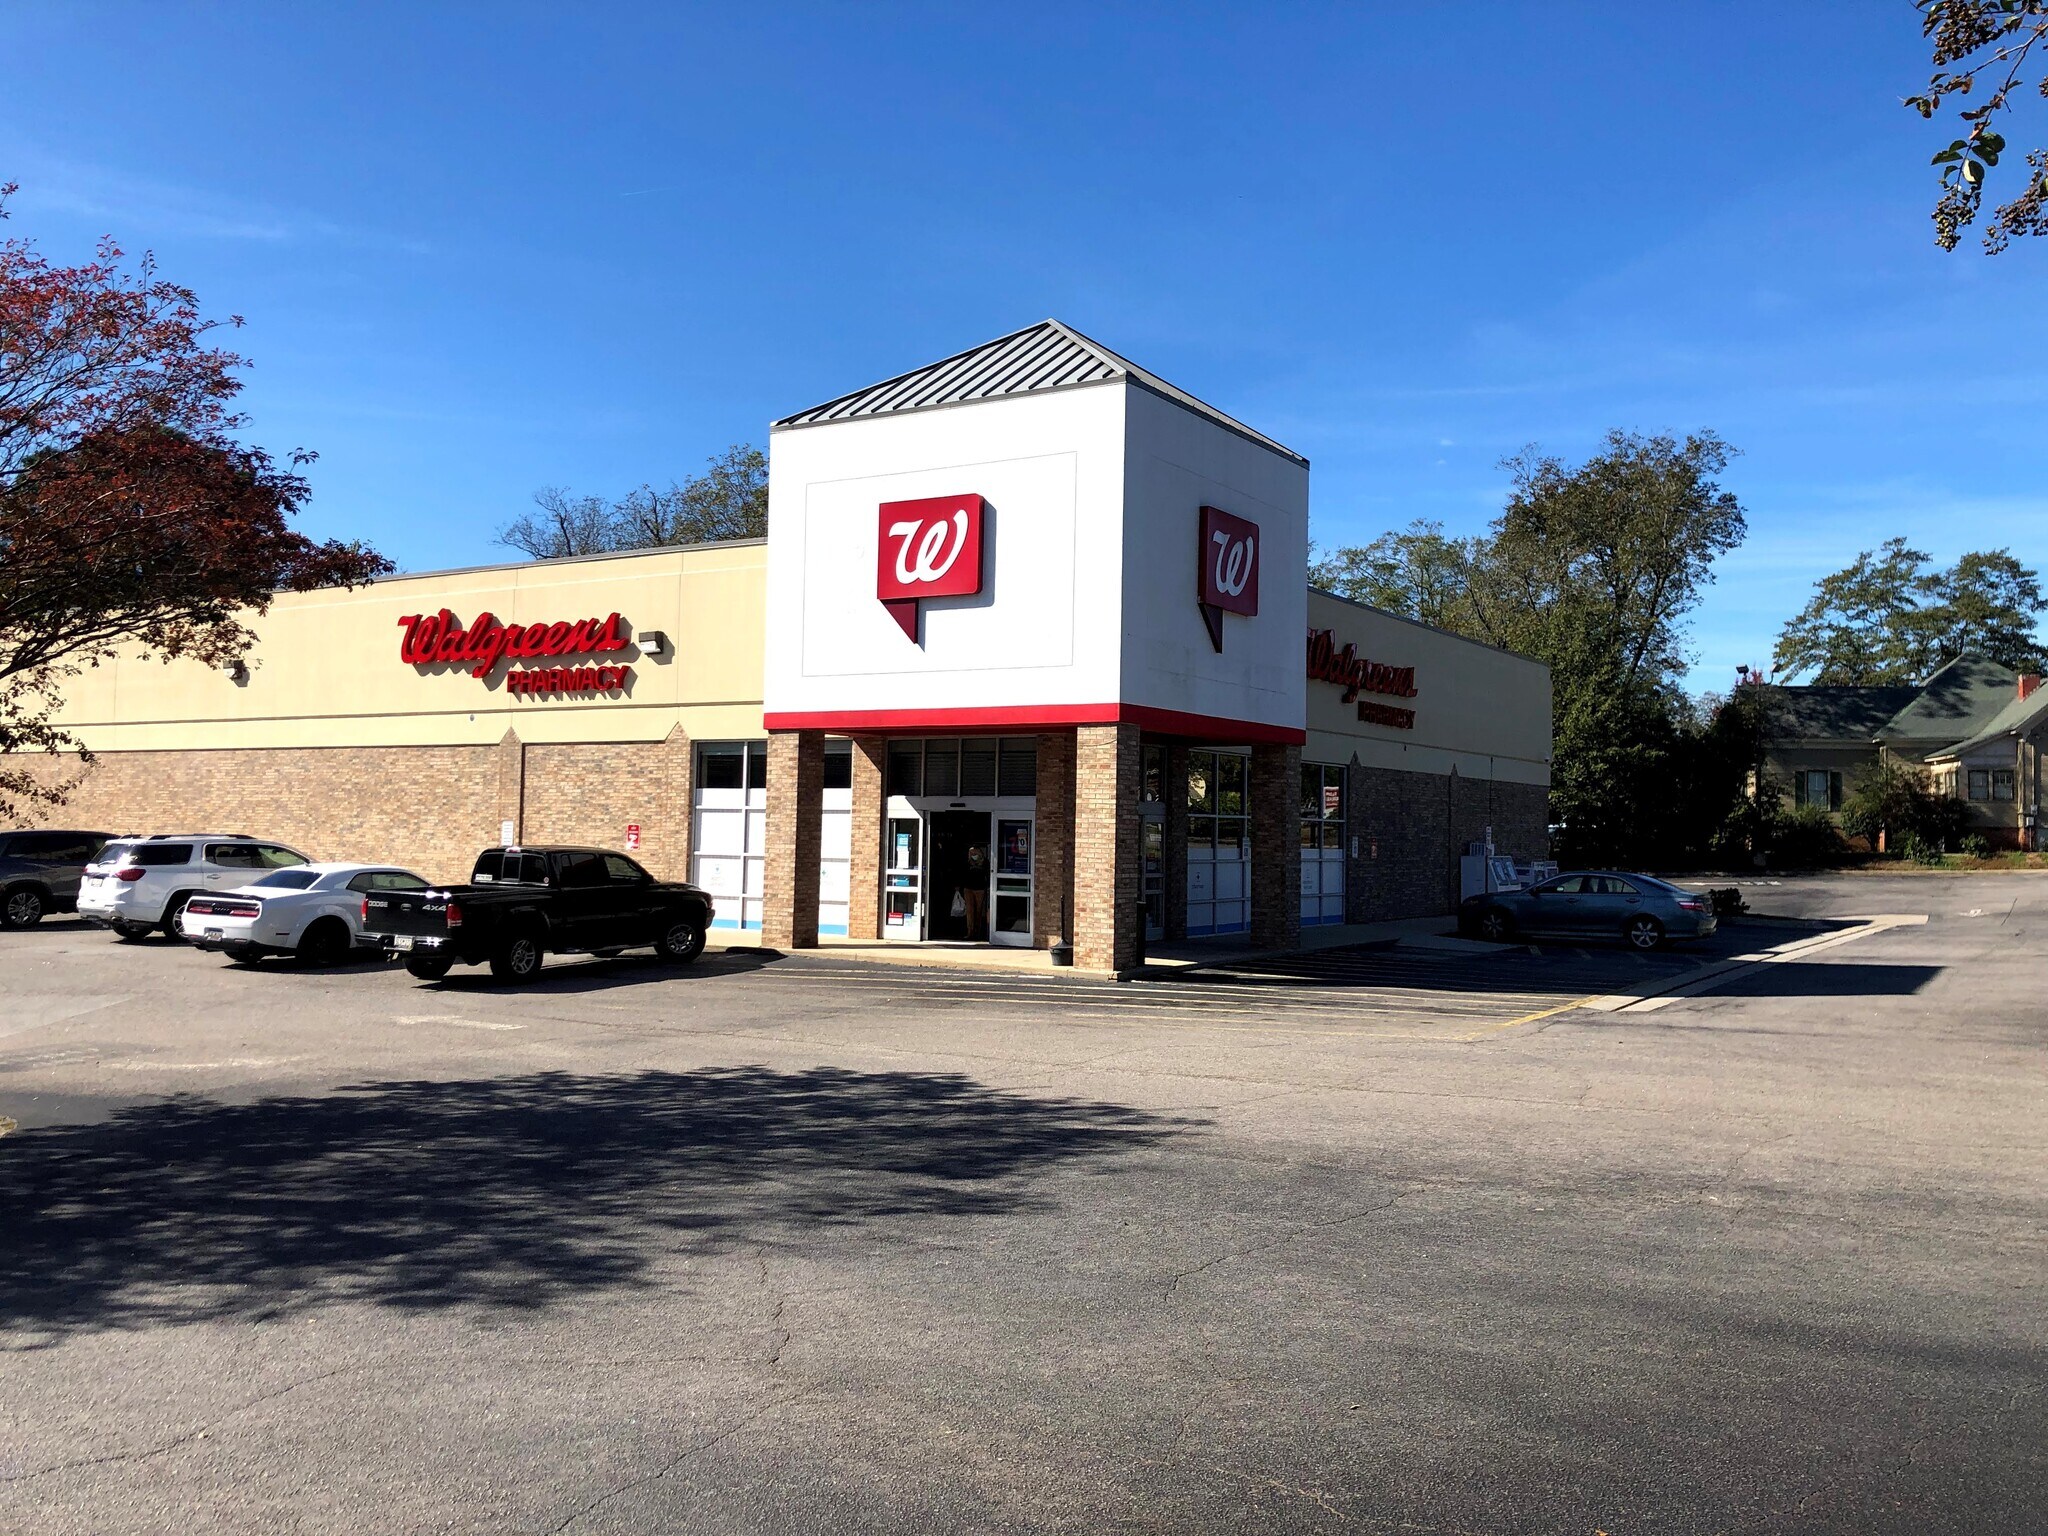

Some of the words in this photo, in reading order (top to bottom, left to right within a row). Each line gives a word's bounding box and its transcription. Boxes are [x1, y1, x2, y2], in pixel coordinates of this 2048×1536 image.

[888, 509, 969, 585] W
[1213, 530, 1254, 597] W
[398, 608, 631, 678] Walgreens
[507, 665, 631, 693] PHARMACY
[1358, 701, 1416, 729] PHARMACY
[368, 900, 389, 908] DODGE
